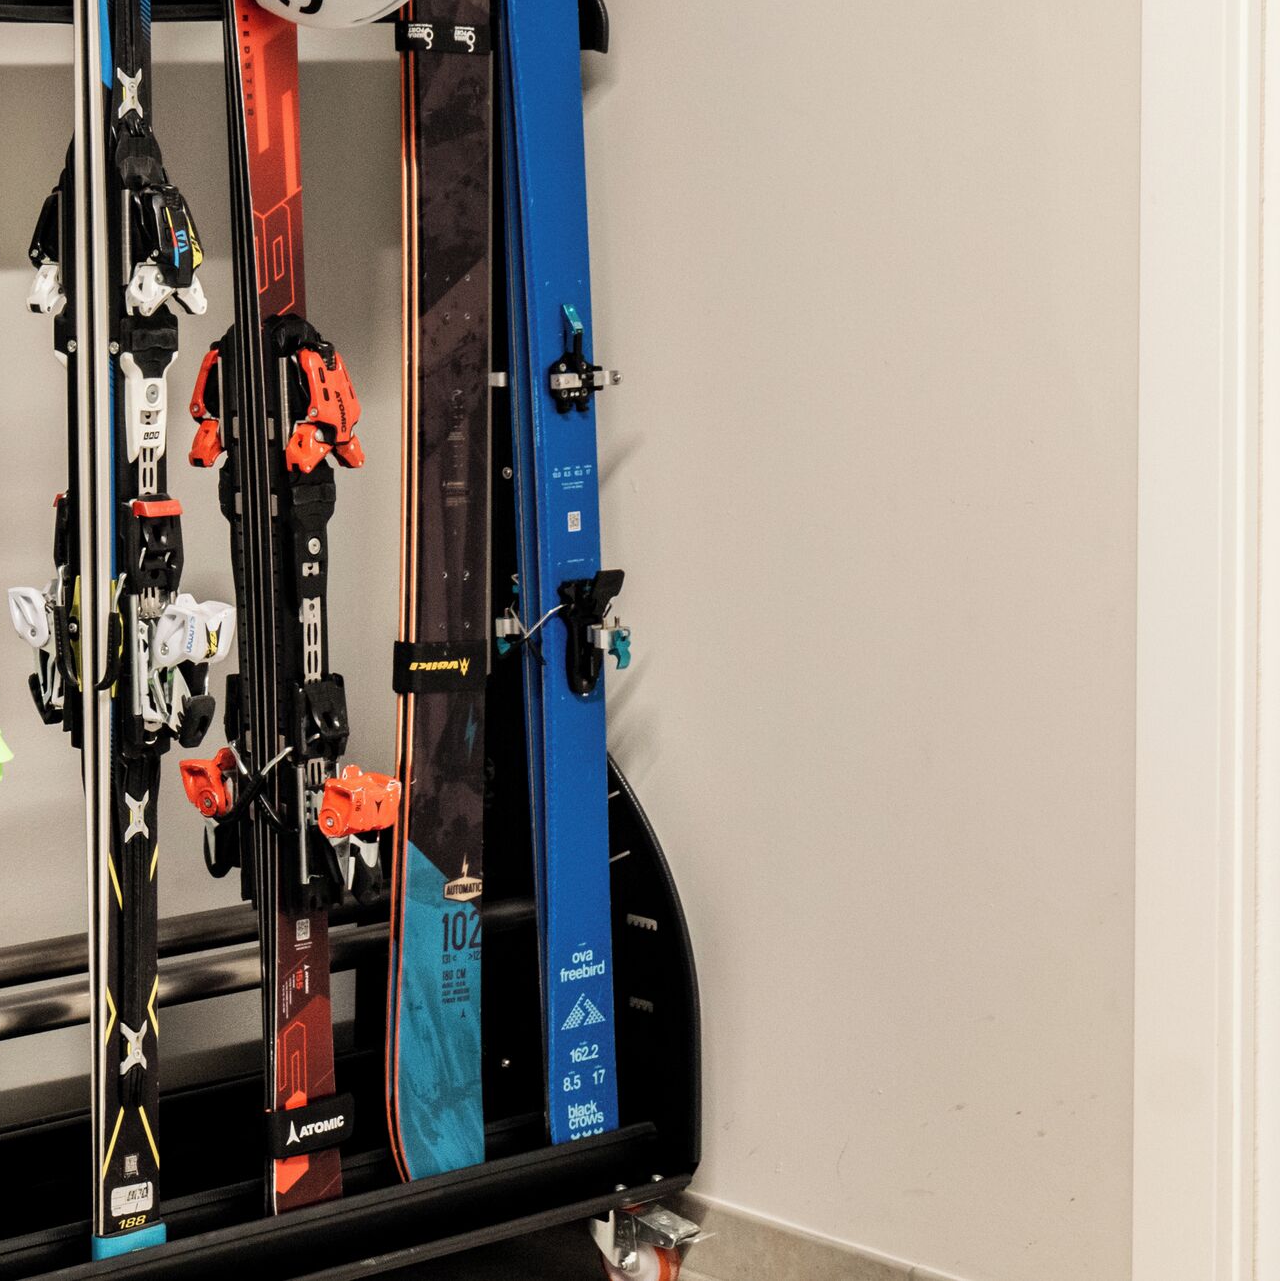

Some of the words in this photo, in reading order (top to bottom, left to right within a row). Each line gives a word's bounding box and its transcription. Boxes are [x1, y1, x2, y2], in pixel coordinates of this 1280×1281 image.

[241, 14, 254, 118] REDSTER
[334, 390, 348, 433] ATOMIC
[446, 882, 482, 896] AUTOMATIC
[442, 910, 481, 951] 102
[572, 949, 593, 964] ova
[560, 960, 606, 983] freebird
[569, 1044, 599, 1064] 162.2
[563, 1075, 581, 1092] 8.5
[592, 1069, 606, 1085] 17
[568, 1100, 597, 1119] black
[569, 1110, 605, 1130] crows
[299, 1115, 345, 1139] ATOMIC
[118, 1214, 147, 1230] 188
